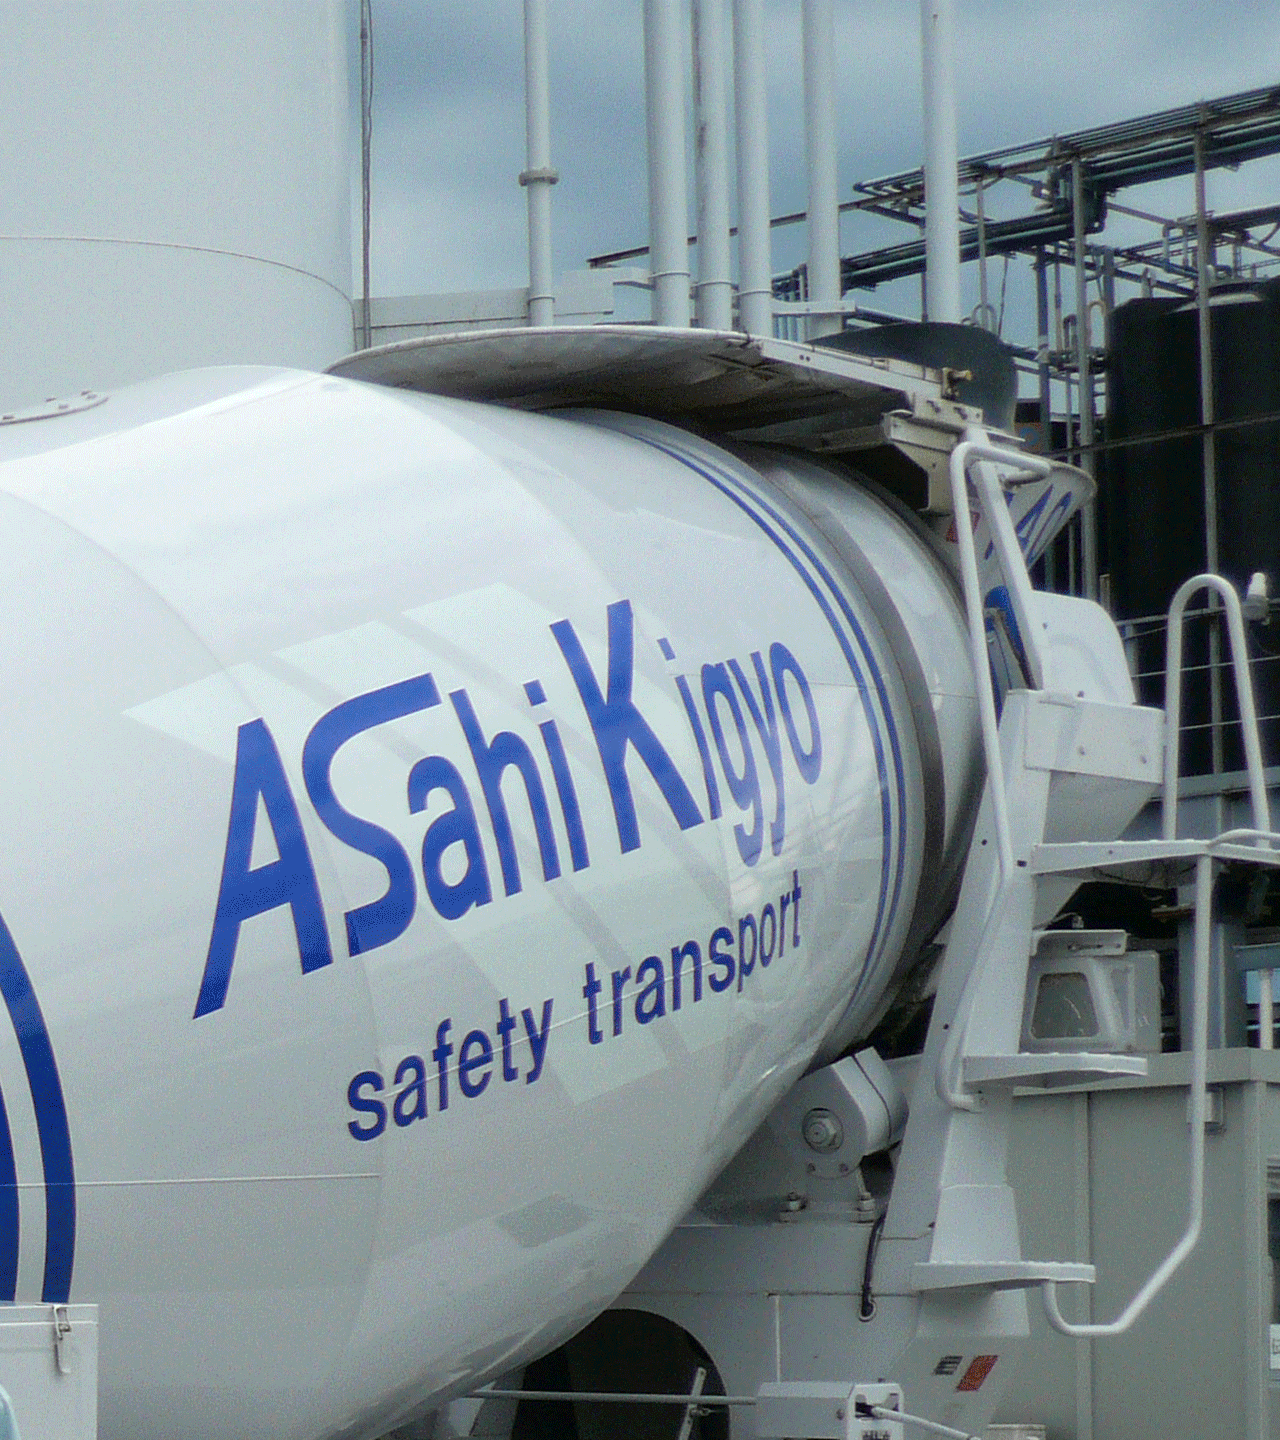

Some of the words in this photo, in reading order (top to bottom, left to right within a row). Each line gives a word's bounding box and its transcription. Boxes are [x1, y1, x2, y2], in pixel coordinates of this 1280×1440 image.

[548, 599, 822, 868] Kigyo
[346, 998, 554, 1141] safety
[582, 869, 802, 1044] transport
